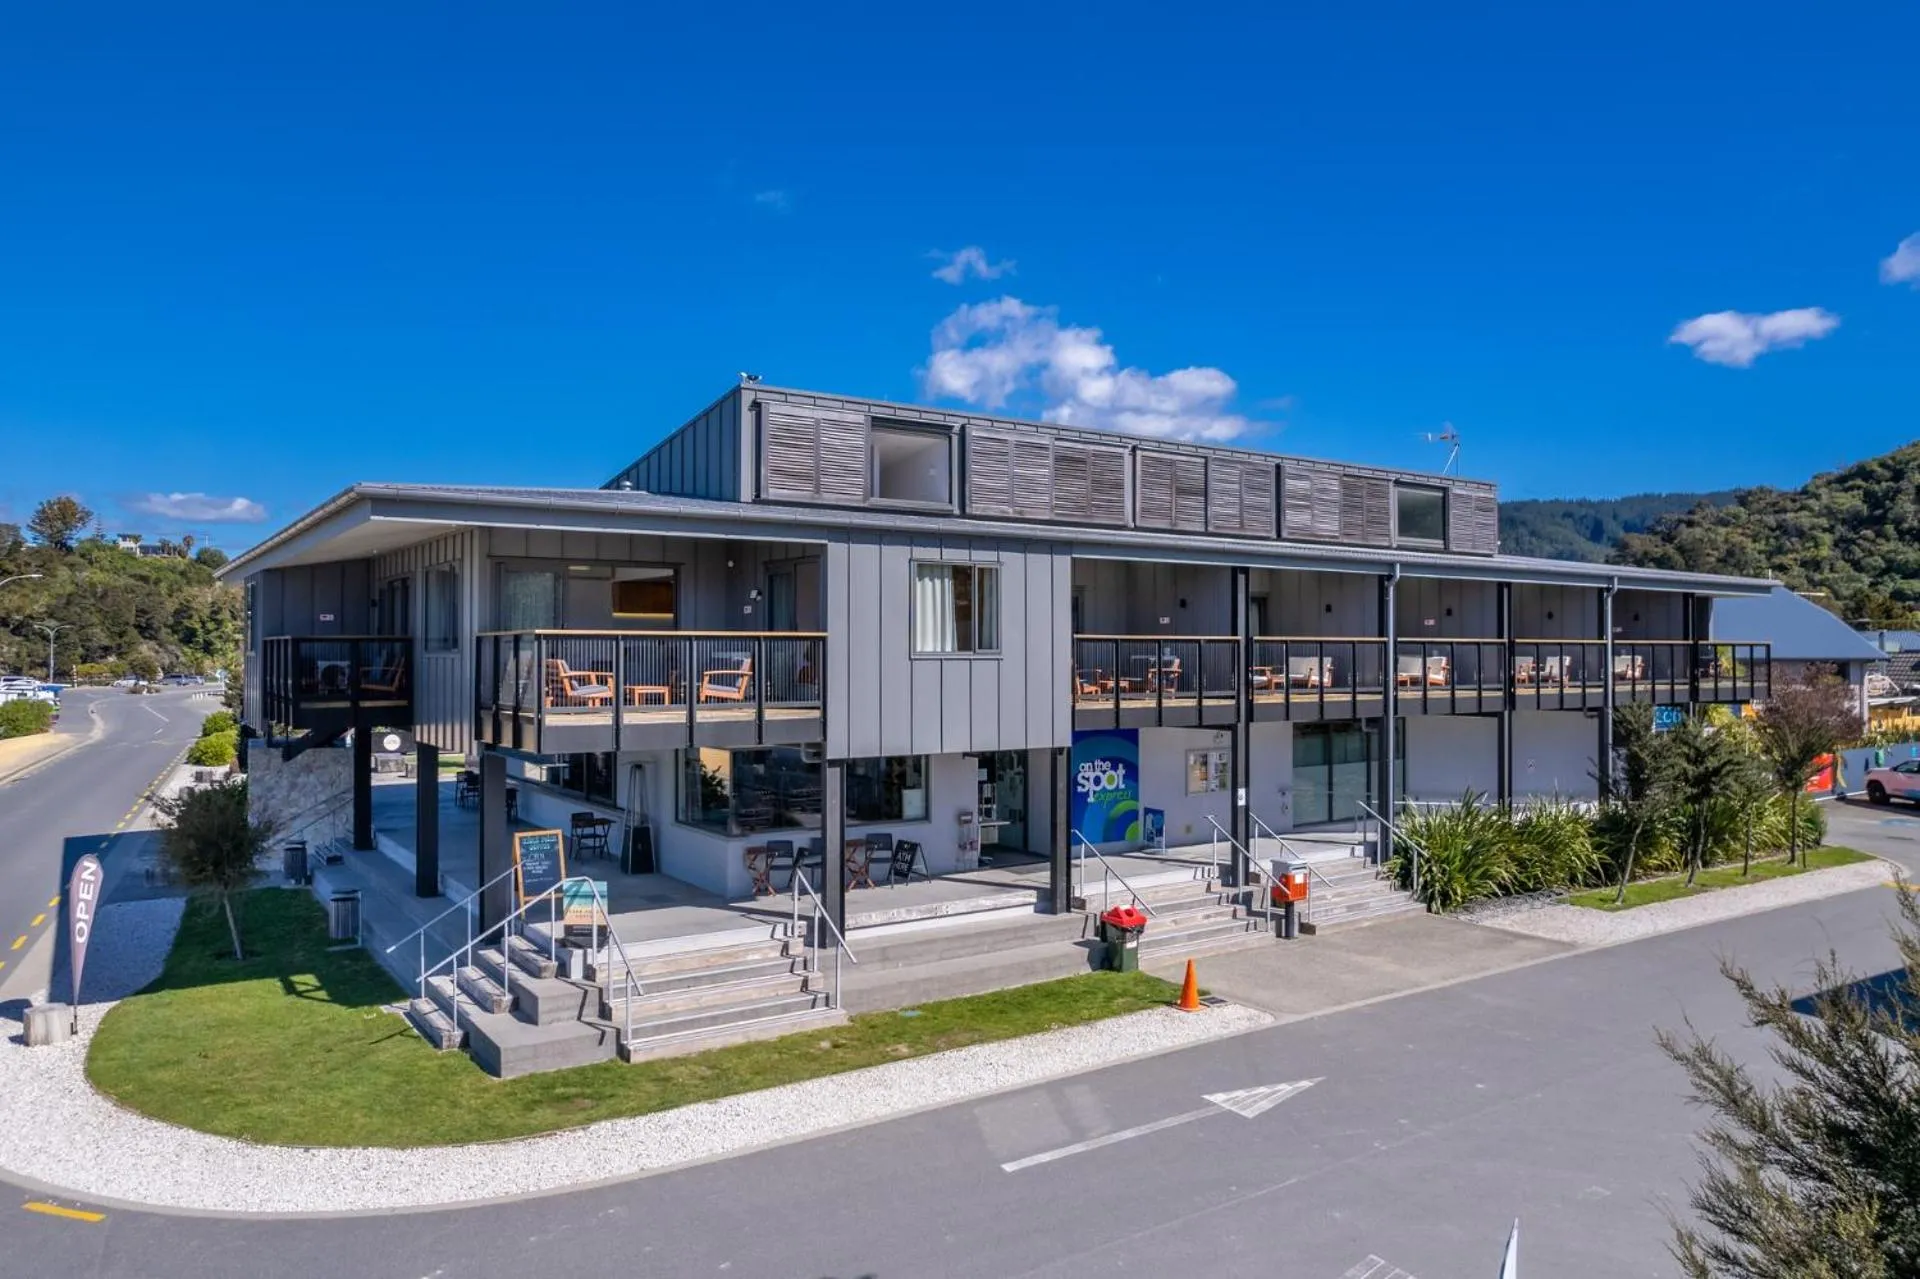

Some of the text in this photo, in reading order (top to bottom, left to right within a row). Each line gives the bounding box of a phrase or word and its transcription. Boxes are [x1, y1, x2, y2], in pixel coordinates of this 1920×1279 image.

[1077, 763, 1126, 802] spot
[1079, 759, 1112, 772] on the
[75, 860, 98, 943] OPEN
